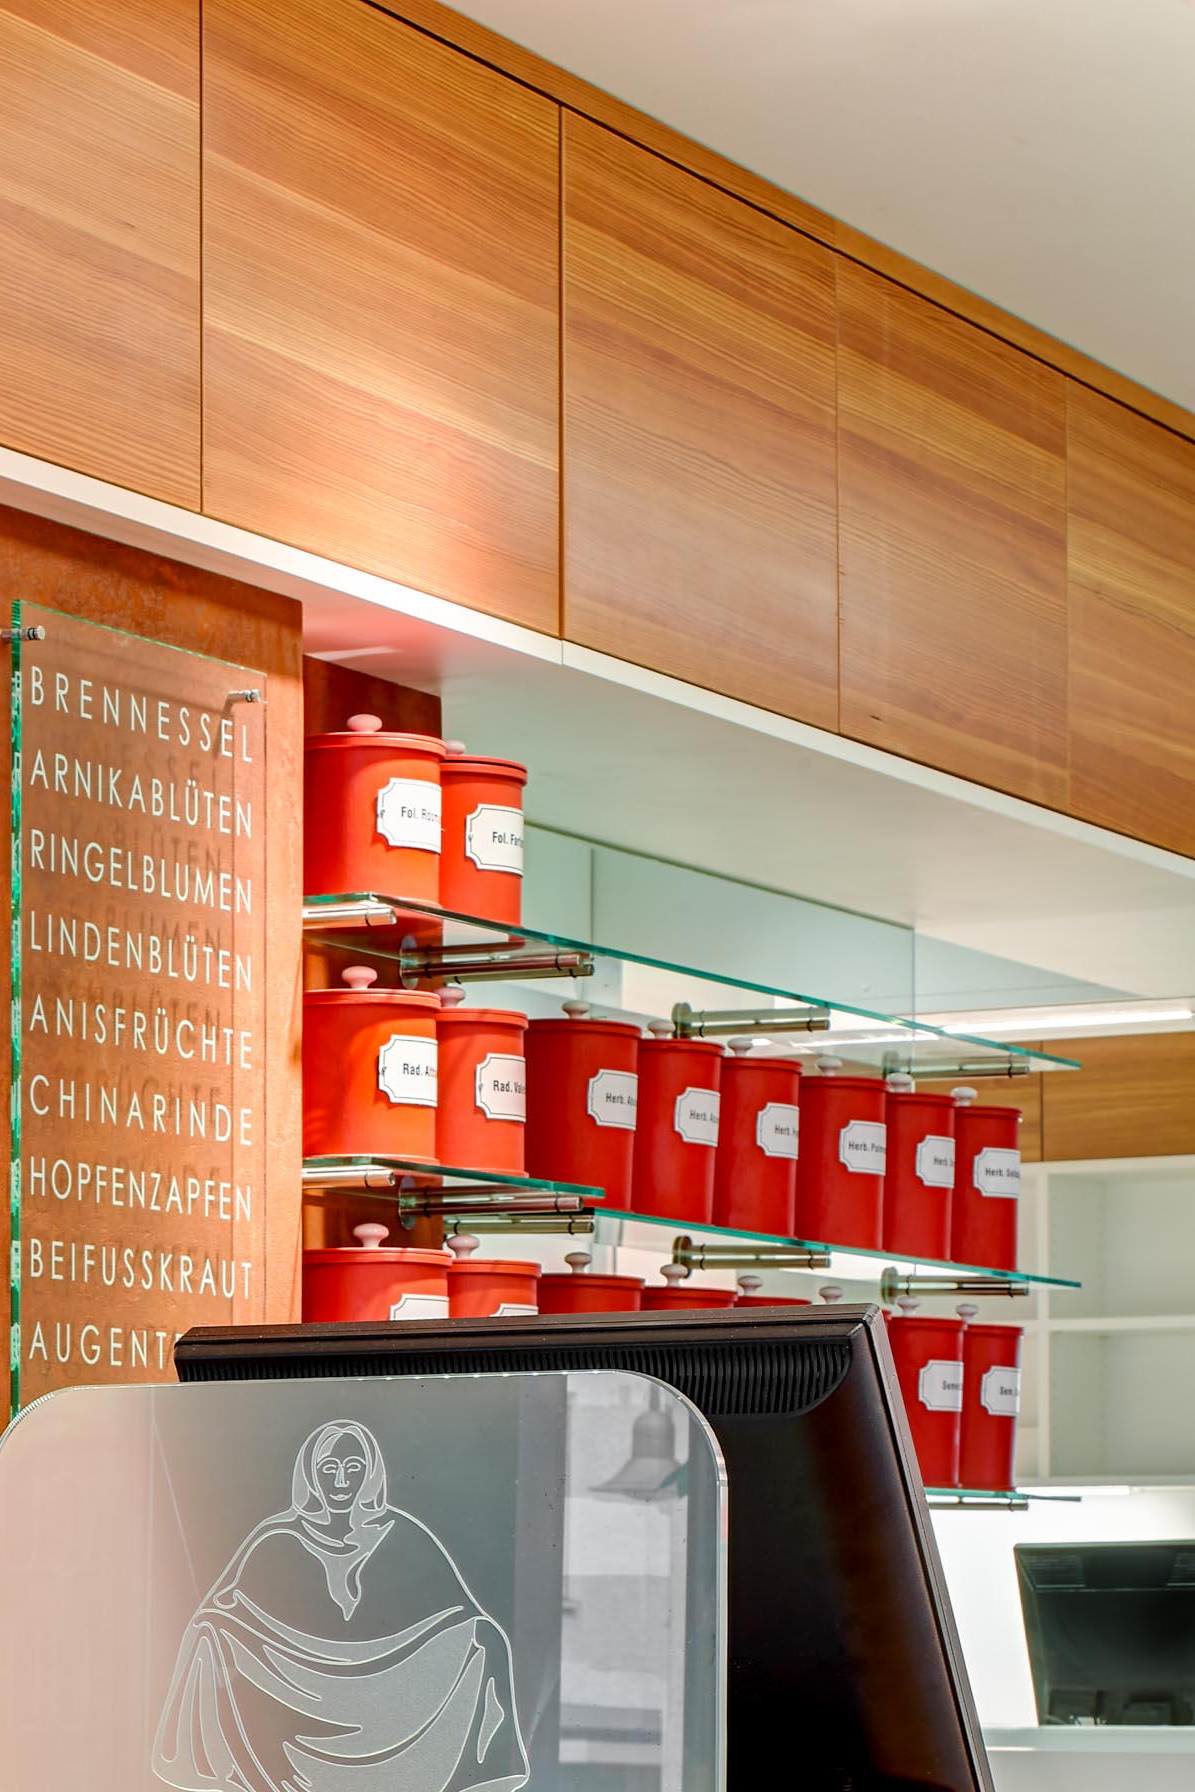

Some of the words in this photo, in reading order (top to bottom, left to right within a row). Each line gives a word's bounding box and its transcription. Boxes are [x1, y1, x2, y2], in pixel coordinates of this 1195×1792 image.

[31, 665, 253, 763] BRENNESSEL
[30, 749, 253, 838] ARNIKABLÜTEN
[401, 806, 419, 820] Fol.
[492, 831, 509, 844] Fol.
[30, 829, 253, 915] RINGELBLUMEN
[30, 910, 253, 993] LINDENBLÜTEN
[29, 993, 253, 1070] ANISFRÜCHTE
[403, 1063, 424, 1076] Rad.
[493, 1080, 513, 1093] Rad.
[29, 1074, 253, 1146] CHINARINDE
[30, 1156, 253, 1222] HOPFENZAPFEN
[30, 1238, 253, 1300] BEIFUSSKRAUT
[29, 1321, 183, 1370] AUGENT
